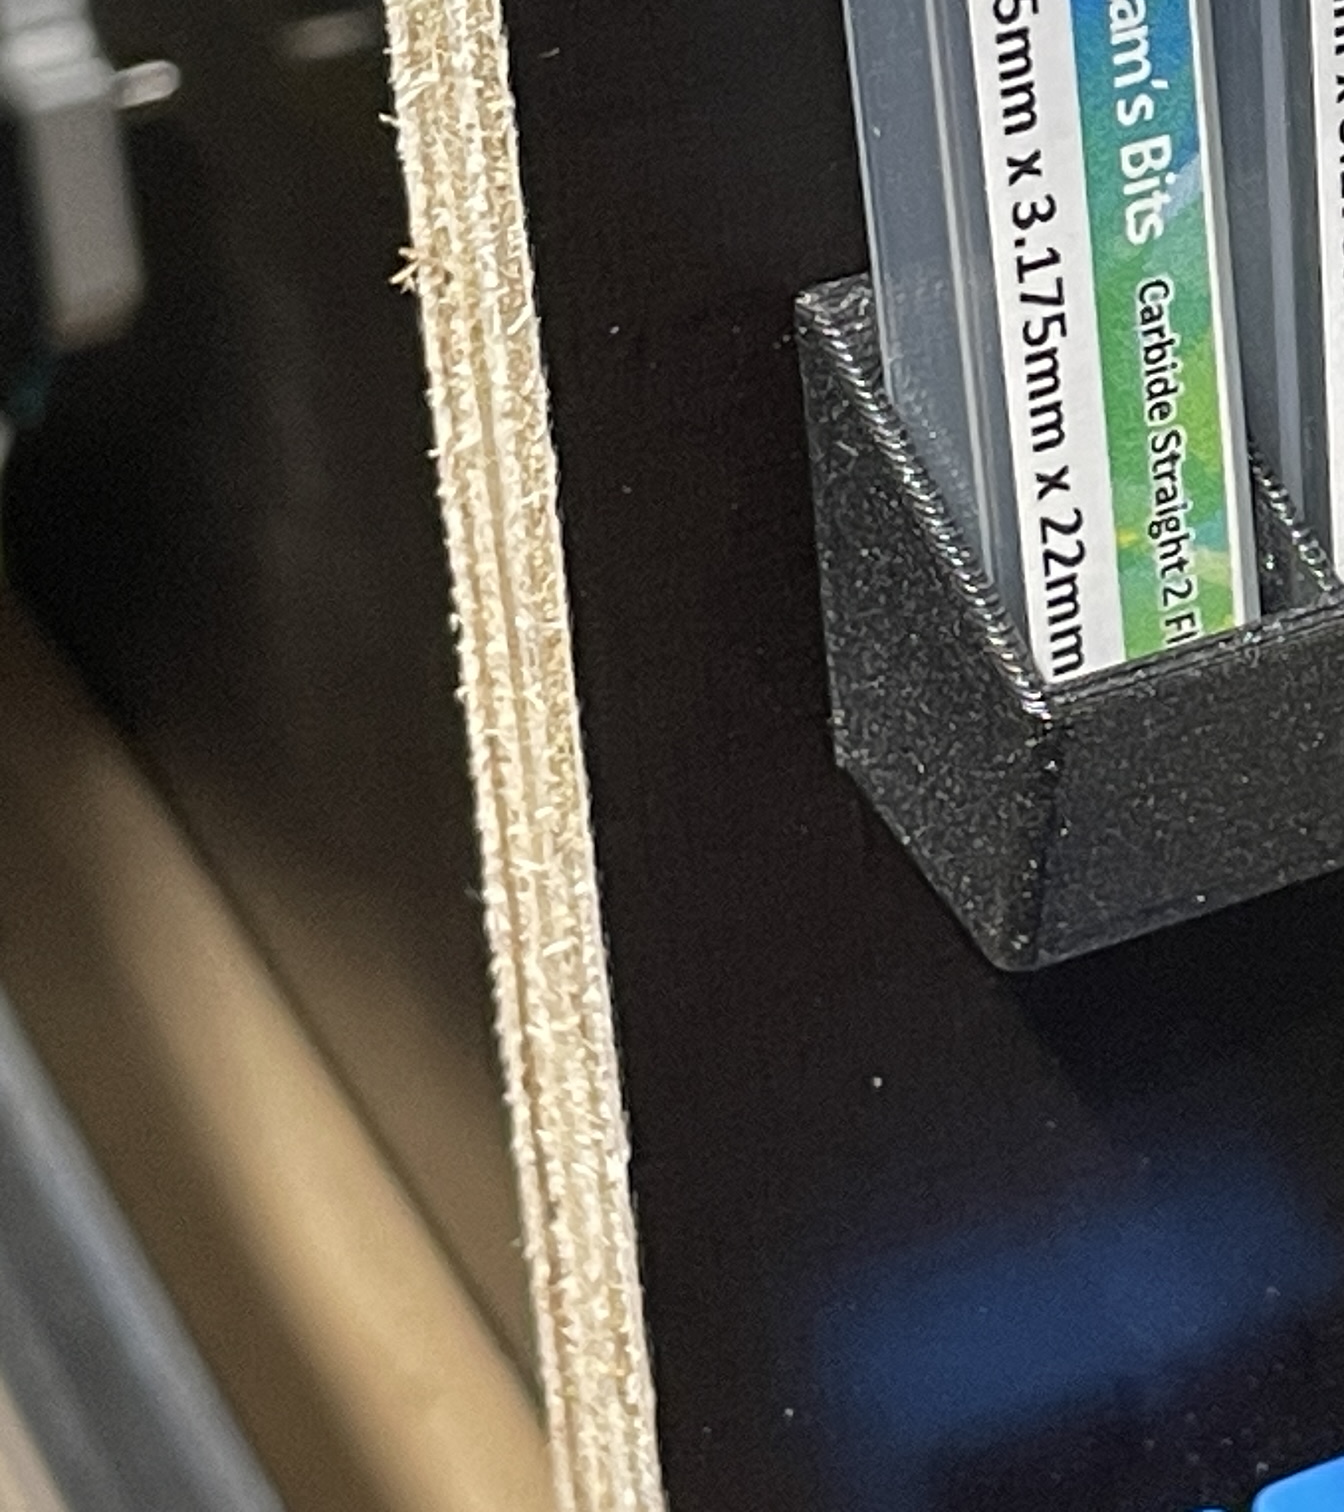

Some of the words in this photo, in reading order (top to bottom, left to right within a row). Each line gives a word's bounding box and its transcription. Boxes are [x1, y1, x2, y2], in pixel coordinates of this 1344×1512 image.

[1006, 148, 1043, 186] x
[1119, 133, 1178, 247] Bits
[1011, 192, 1068, 454] 3.175mm
[1139, 278, 1180, 422] Carbide
[1034, 464, 1071, 502] x
[1148, 428, 1191, 577] Straight
[1039, 506, 1087, 678] 22mm
[1163, 578, 1194, 607] 2
